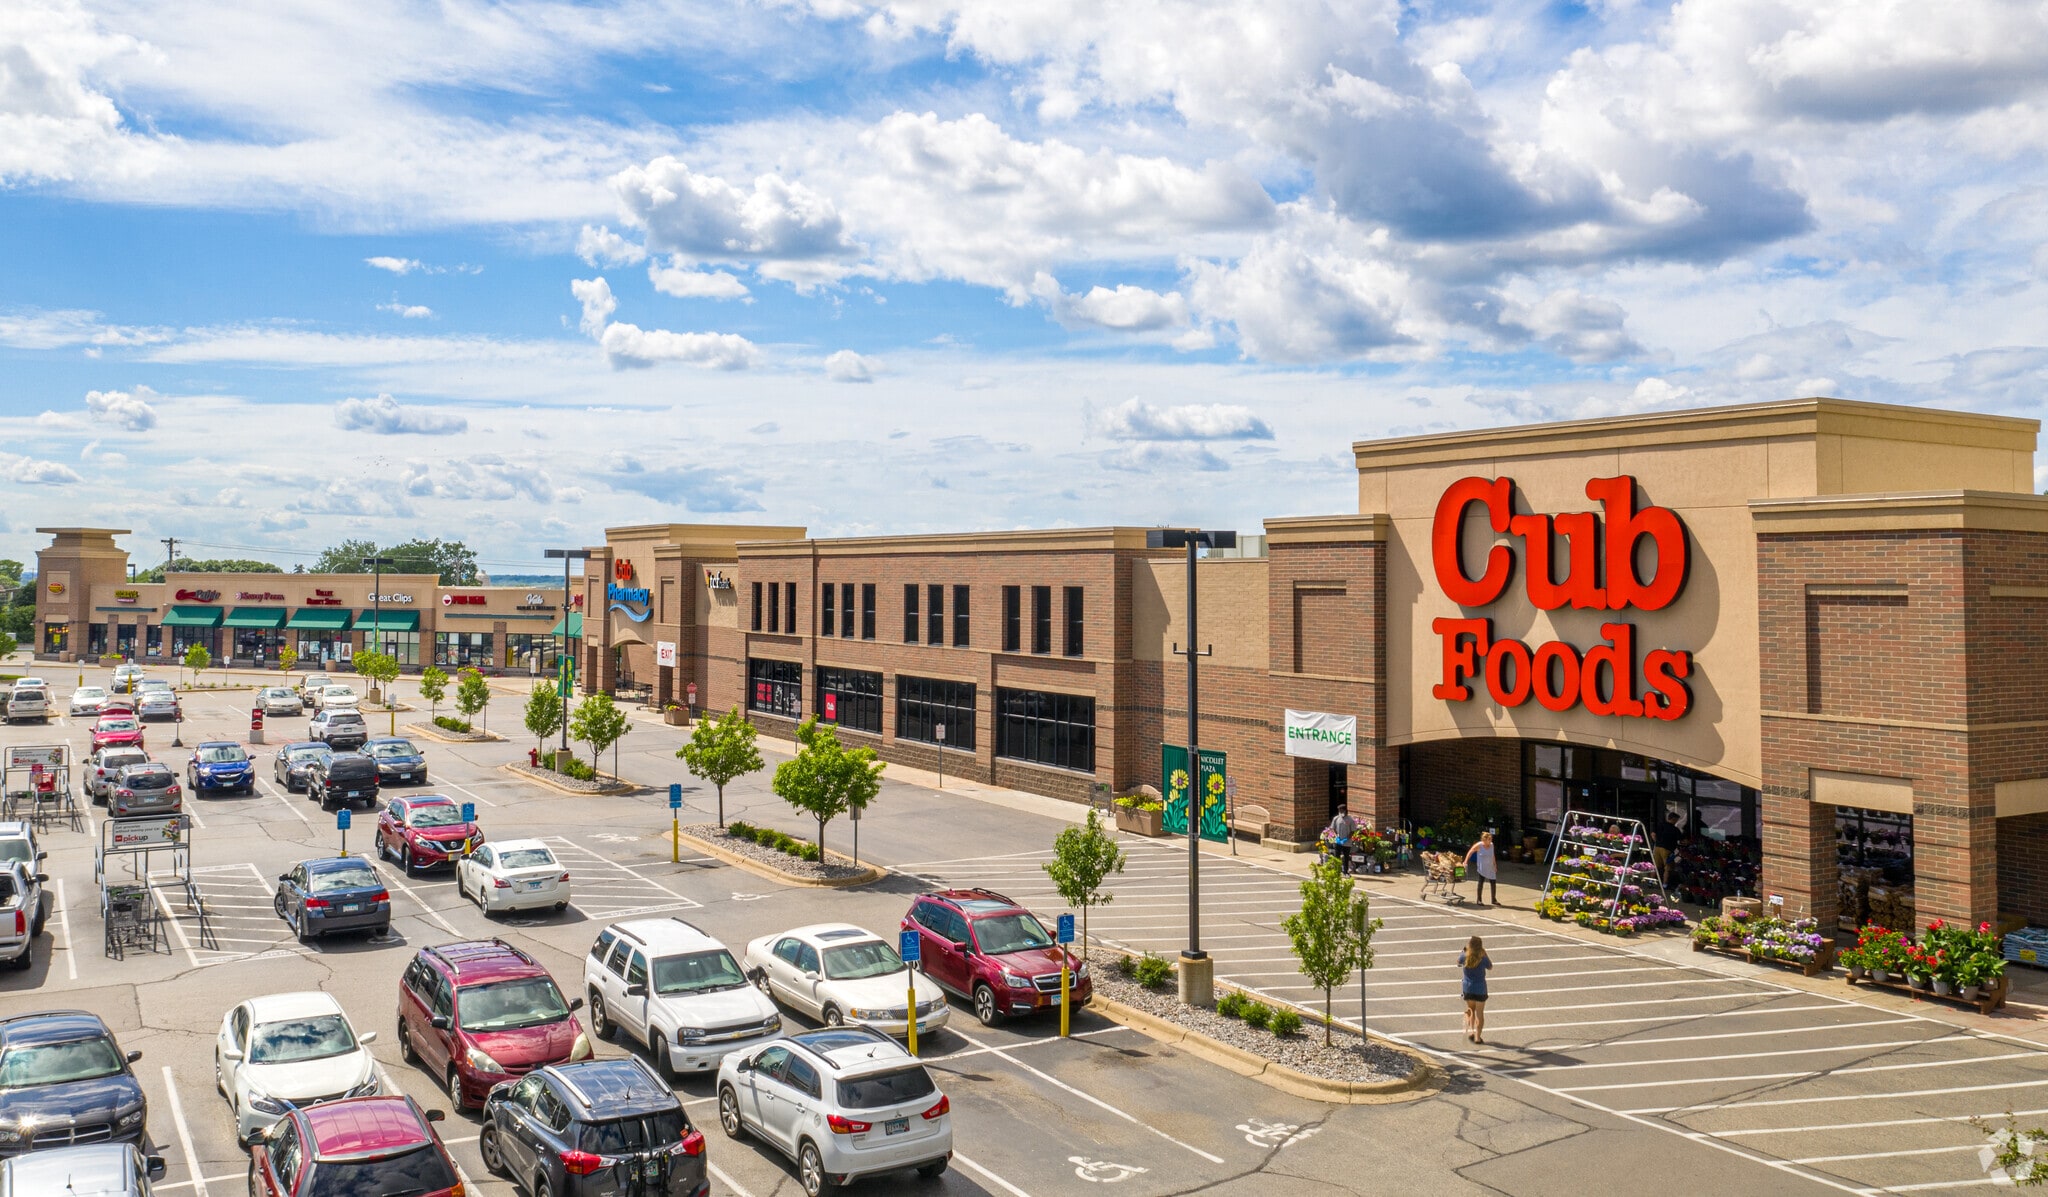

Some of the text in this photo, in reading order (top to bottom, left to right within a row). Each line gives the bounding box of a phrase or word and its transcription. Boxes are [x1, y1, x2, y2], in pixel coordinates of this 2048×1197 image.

[1432, 475, 1690, 611] Cub
[615, 559, 633, 580] Cub
[709, 571, 721, 589] tcf
[368, 592, 413, 604] Geat Clips
[607, 583, 650, 606] Pharmacy
[661, 648, 673, 660] EXIT
[1432, 616, 1692, 721] Foods
[1288, 726, 1352, 745] ENTRANCE
[1200, 756, 1224, 765] NICOLLET
